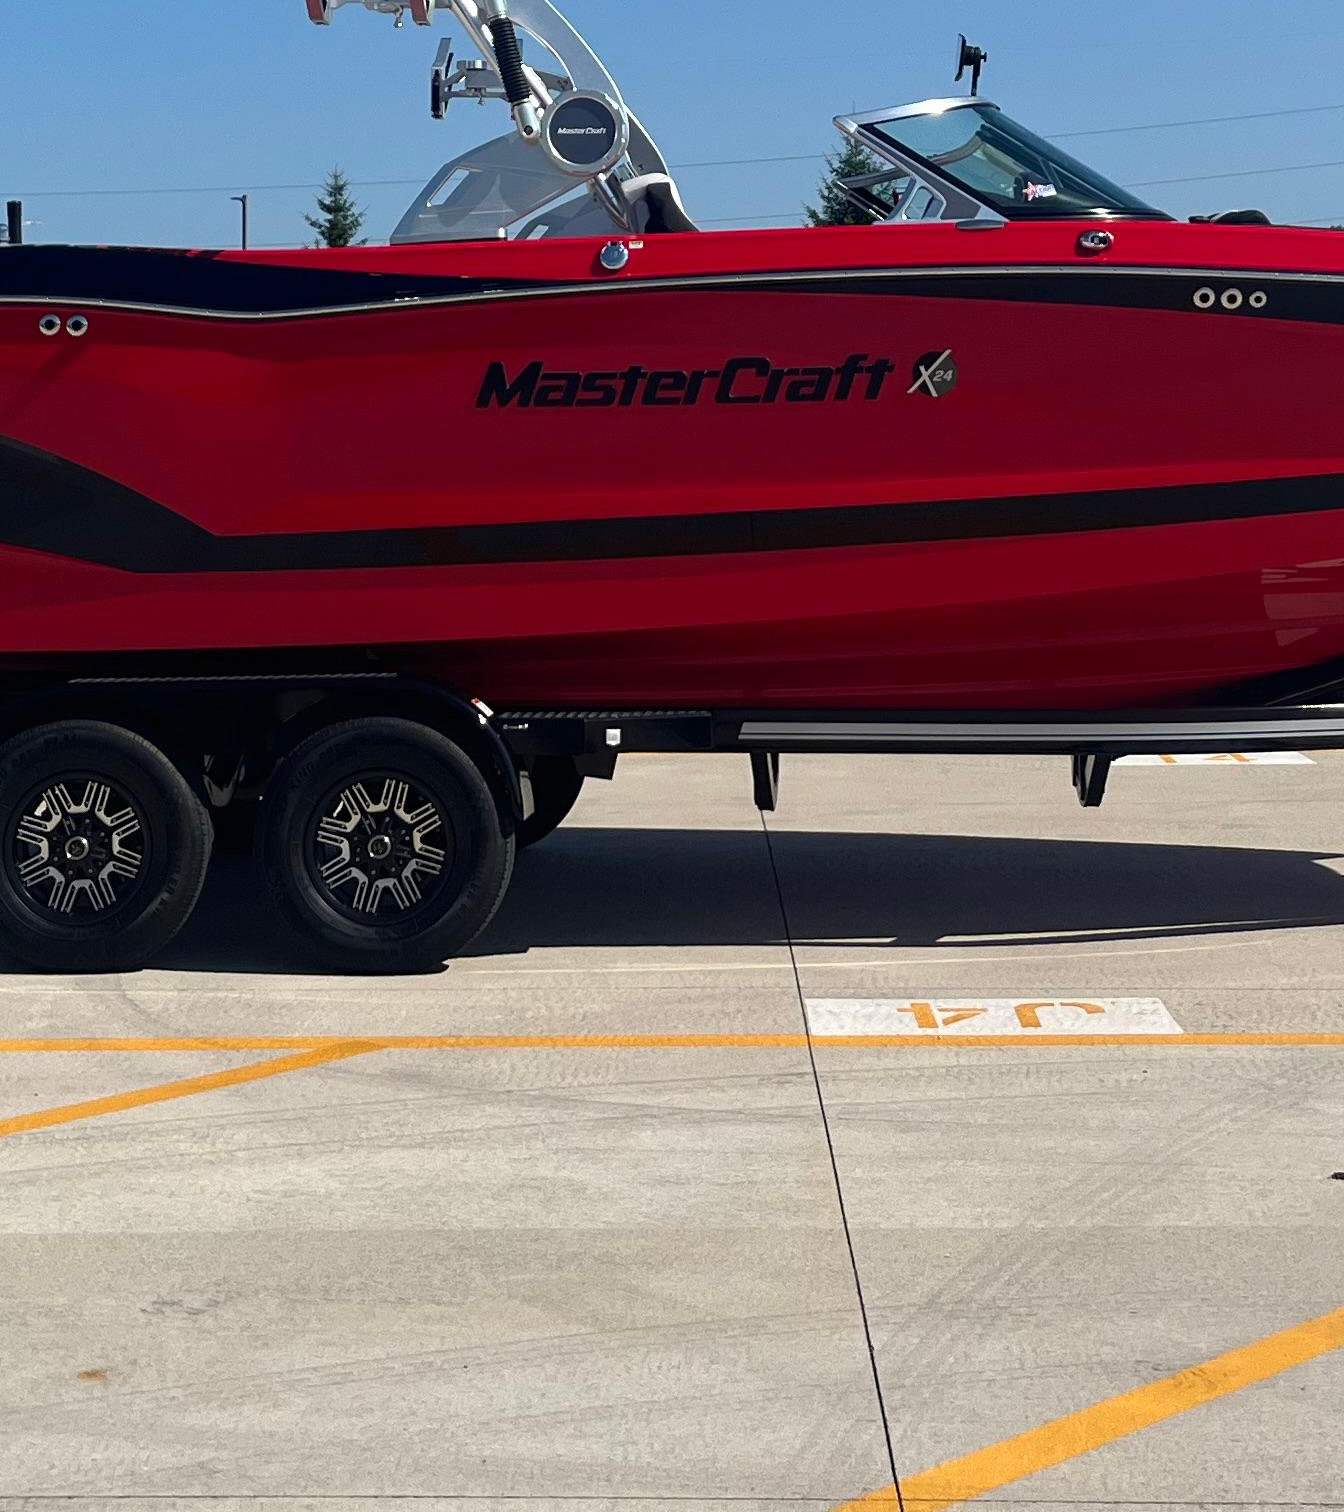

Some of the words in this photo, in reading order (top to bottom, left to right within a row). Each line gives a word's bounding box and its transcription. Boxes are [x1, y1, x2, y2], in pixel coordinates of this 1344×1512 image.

[557, 125, 607, 136] MasterCraft
[474, 353, 896, 409] MasterCraft
[906, 348, 954, 398] X24
[897, 1001, 1106, 1029] J4
